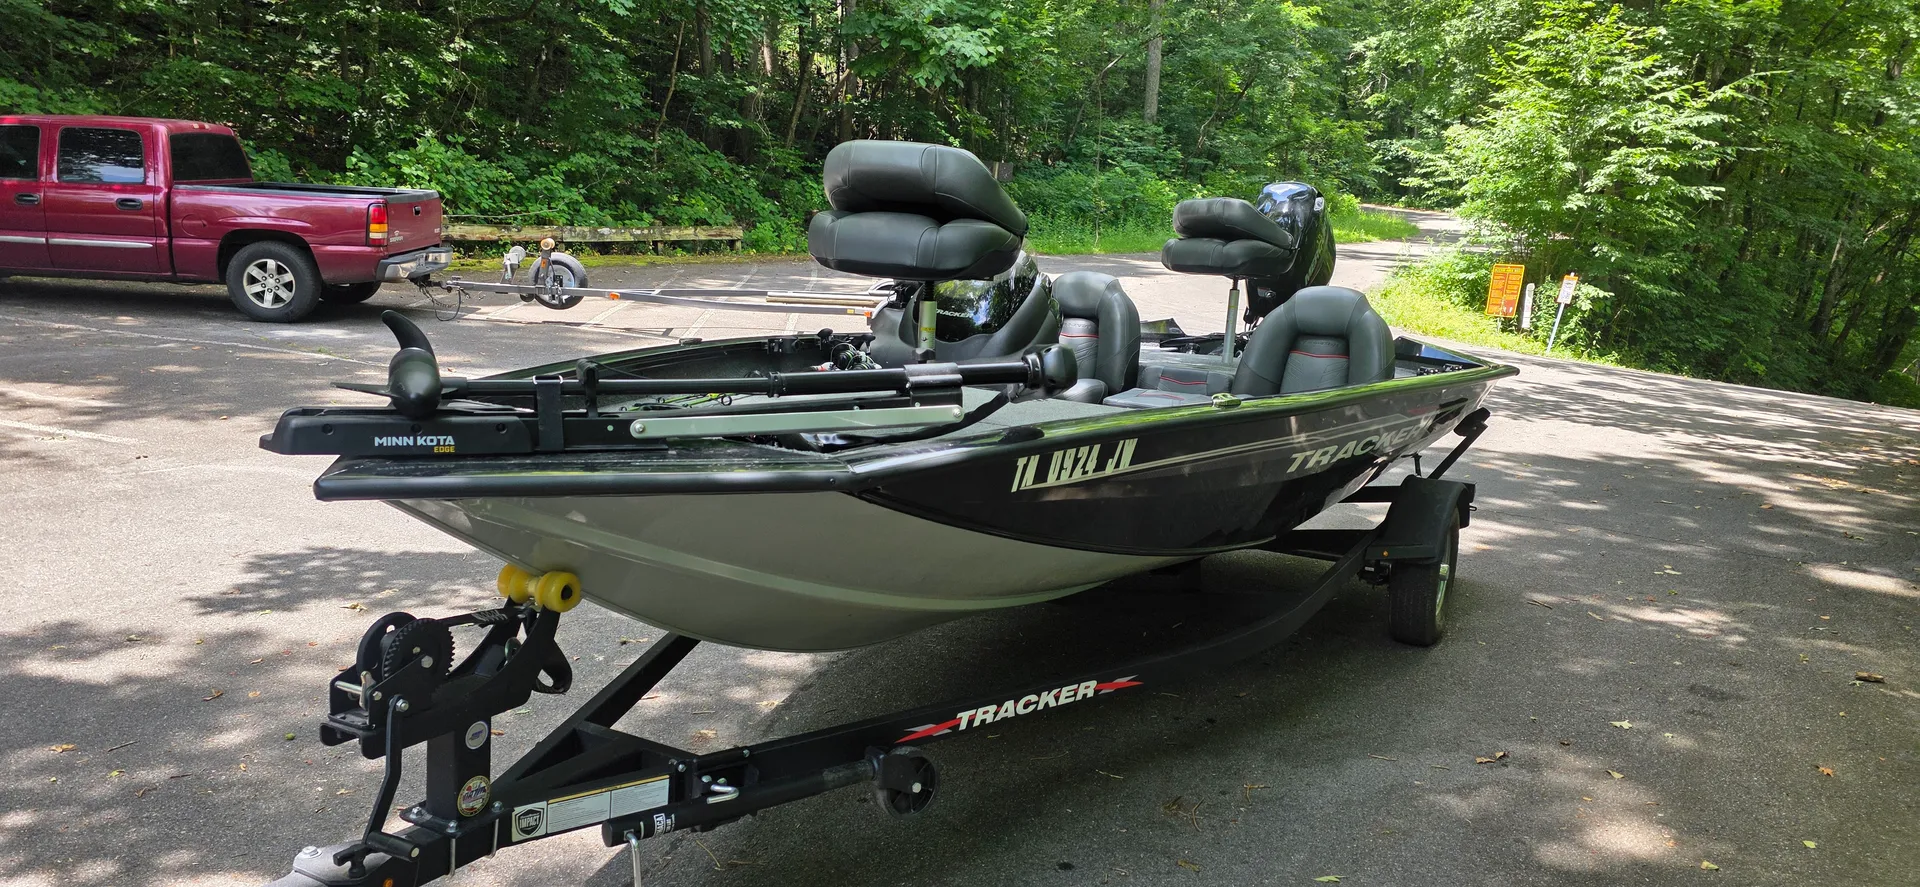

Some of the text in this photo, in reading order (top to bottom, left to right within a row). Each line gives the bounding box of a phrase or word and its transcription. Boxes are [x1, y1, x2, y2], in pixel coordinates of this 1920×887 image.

[936, 308, 973, 318] RACKER
[374, 435, 455, 447] MINN KOTA
[1286, 424, 1422, 473] TRACKER
[1011, 438, 1139, 493] TN 0924 JW
[956, 679, 1098, 731] TRACKER
[519, 814, 540, 829] IMPACT
